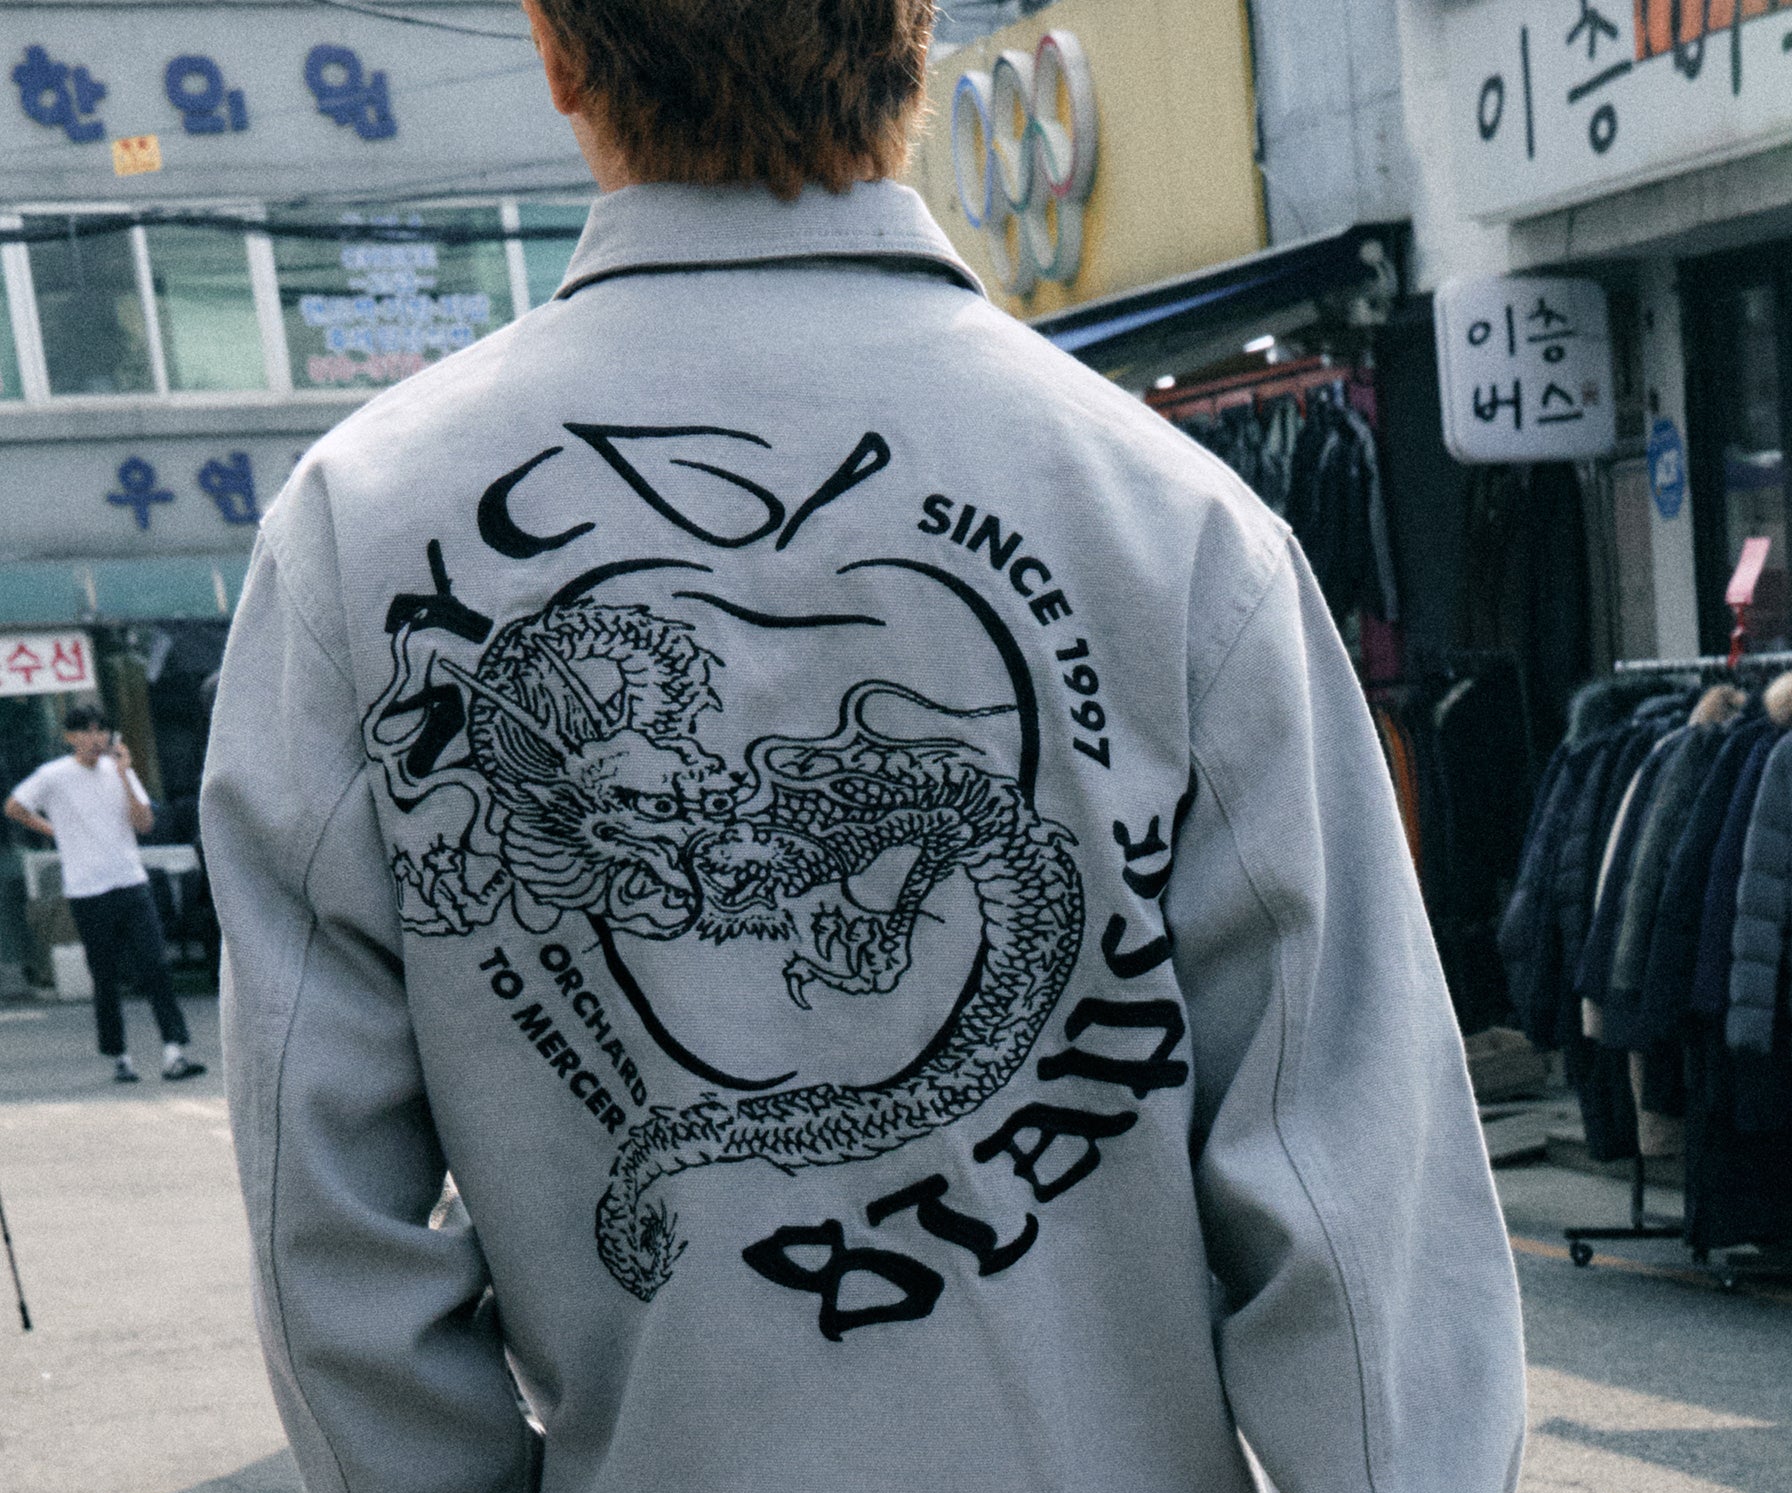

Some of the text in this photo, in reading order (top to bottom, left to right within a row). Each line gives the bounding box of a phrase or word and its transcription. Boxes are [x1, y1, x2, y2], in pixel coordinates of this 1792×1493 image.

[105, 450, 304, 530] 우연
[0, 638, 87, 685] 수선
[917, 493, 1111, 769] SINCE 1997
[479, 946, 626, 1135] TO MERCER
[539, 943, 648, 1108] ORCHARD
